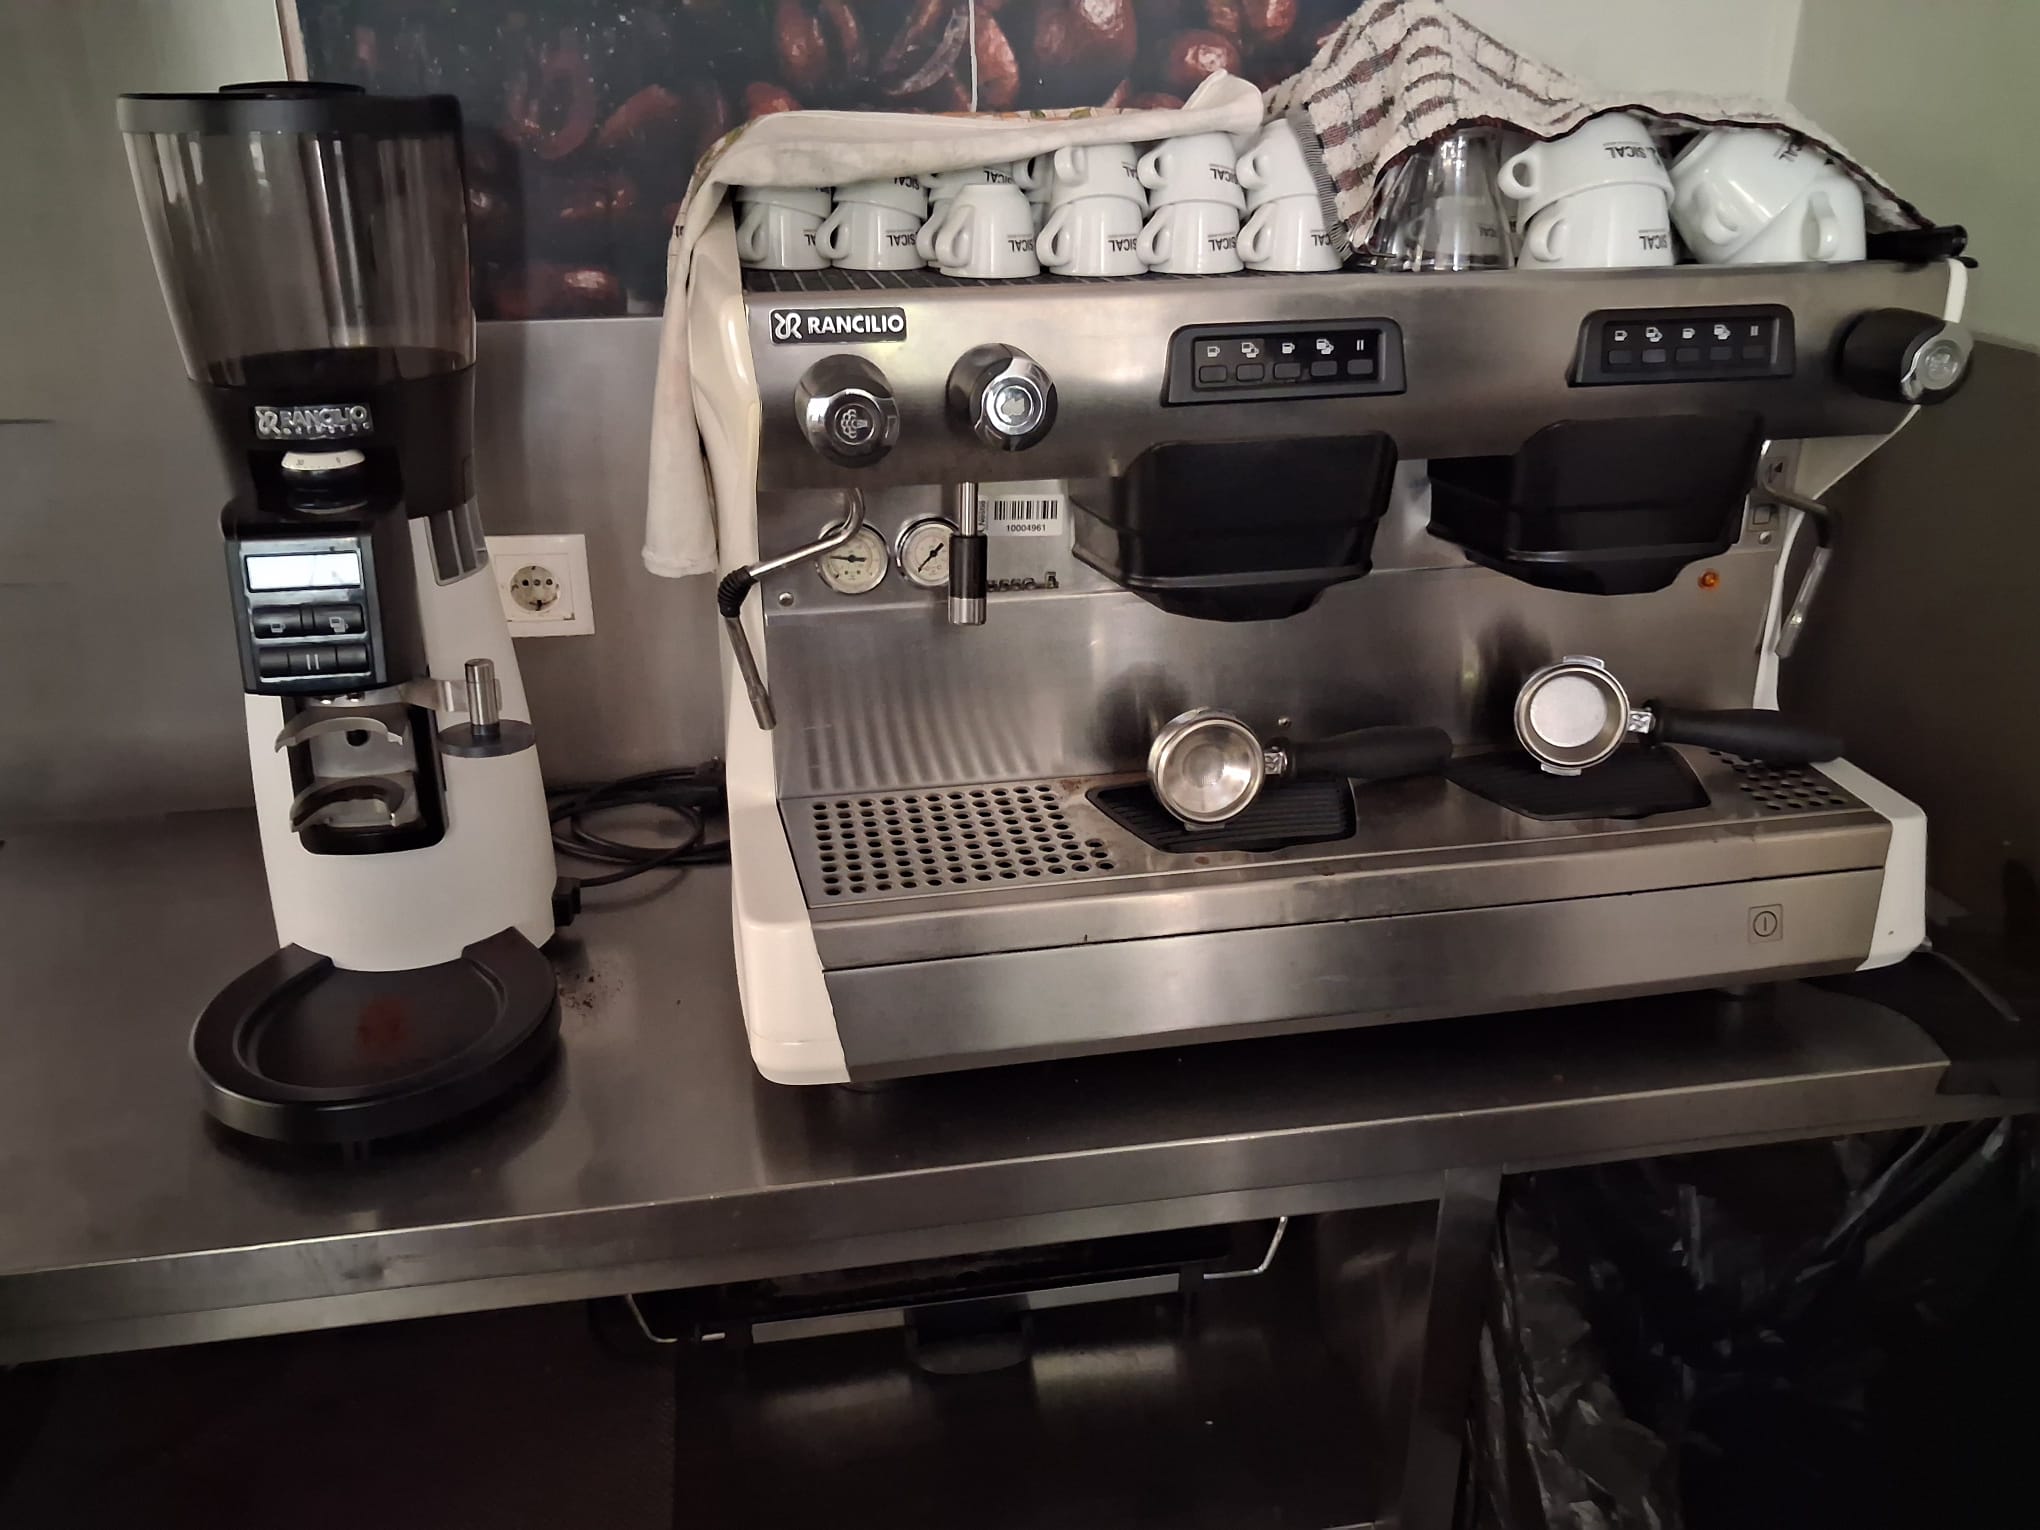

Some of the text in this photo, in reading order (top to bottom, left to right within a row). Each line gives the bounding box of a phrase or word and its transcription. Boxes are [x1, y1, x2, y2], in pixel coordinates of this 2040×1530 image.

[1605, 146, 1647, 159] SICAL
[886, 232, 916, 247] SICAL
[1311, 234, 1332, 247] CAL
[1639, 235, 1668, 250] SICAL
[808, 314, 904, 335] RANCILIO
[1007, 524, 1046, 532] 10004961
